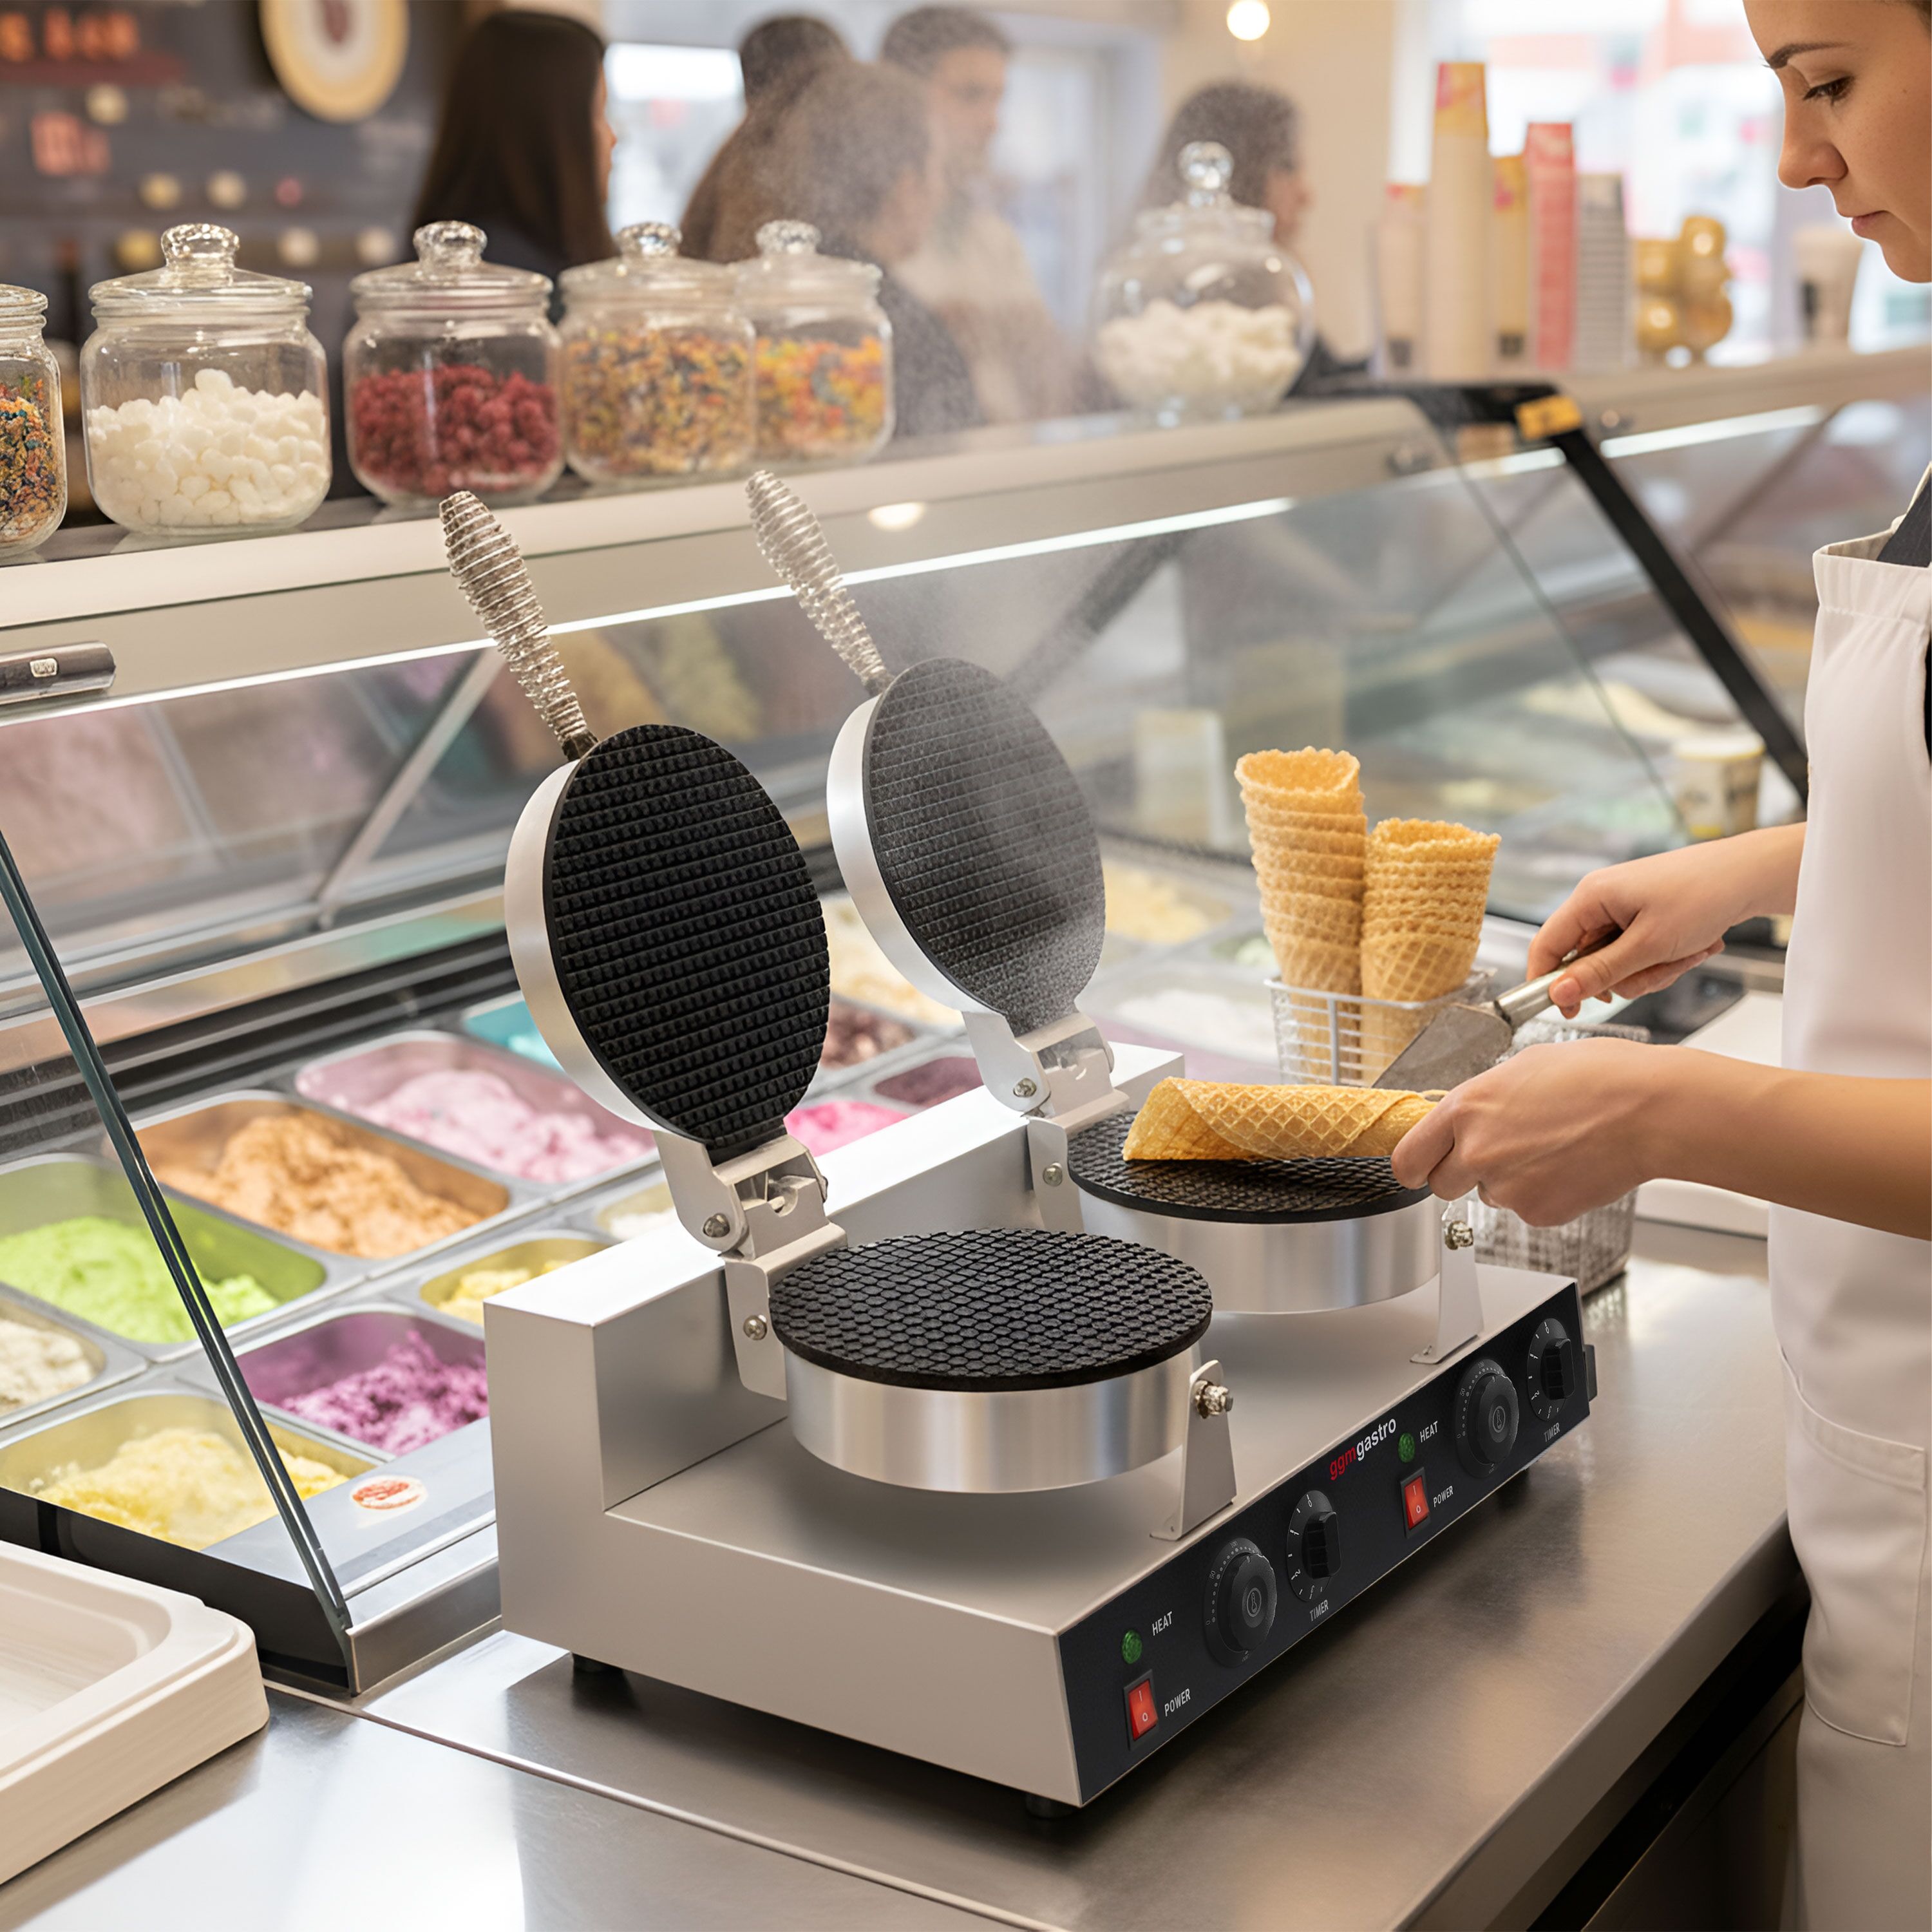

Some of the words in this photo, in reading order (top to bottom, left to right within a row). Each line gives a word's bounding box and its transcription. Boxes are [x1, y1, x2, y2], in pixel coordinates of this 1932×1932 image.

[1419, 1420, 1438, 1443] HEAT
[1544, 1422, 1560, 1443] TIMER
[1329, 1418, 1397, 1481] ggmgastro
[1433, 1485, 1454, 1508] POWER
[1309, 1599, 1329, 1622] TIMER
[1151, 1611, 1173, 1636] HEAT
[1164, 1688, 1191, 1717] POWER
